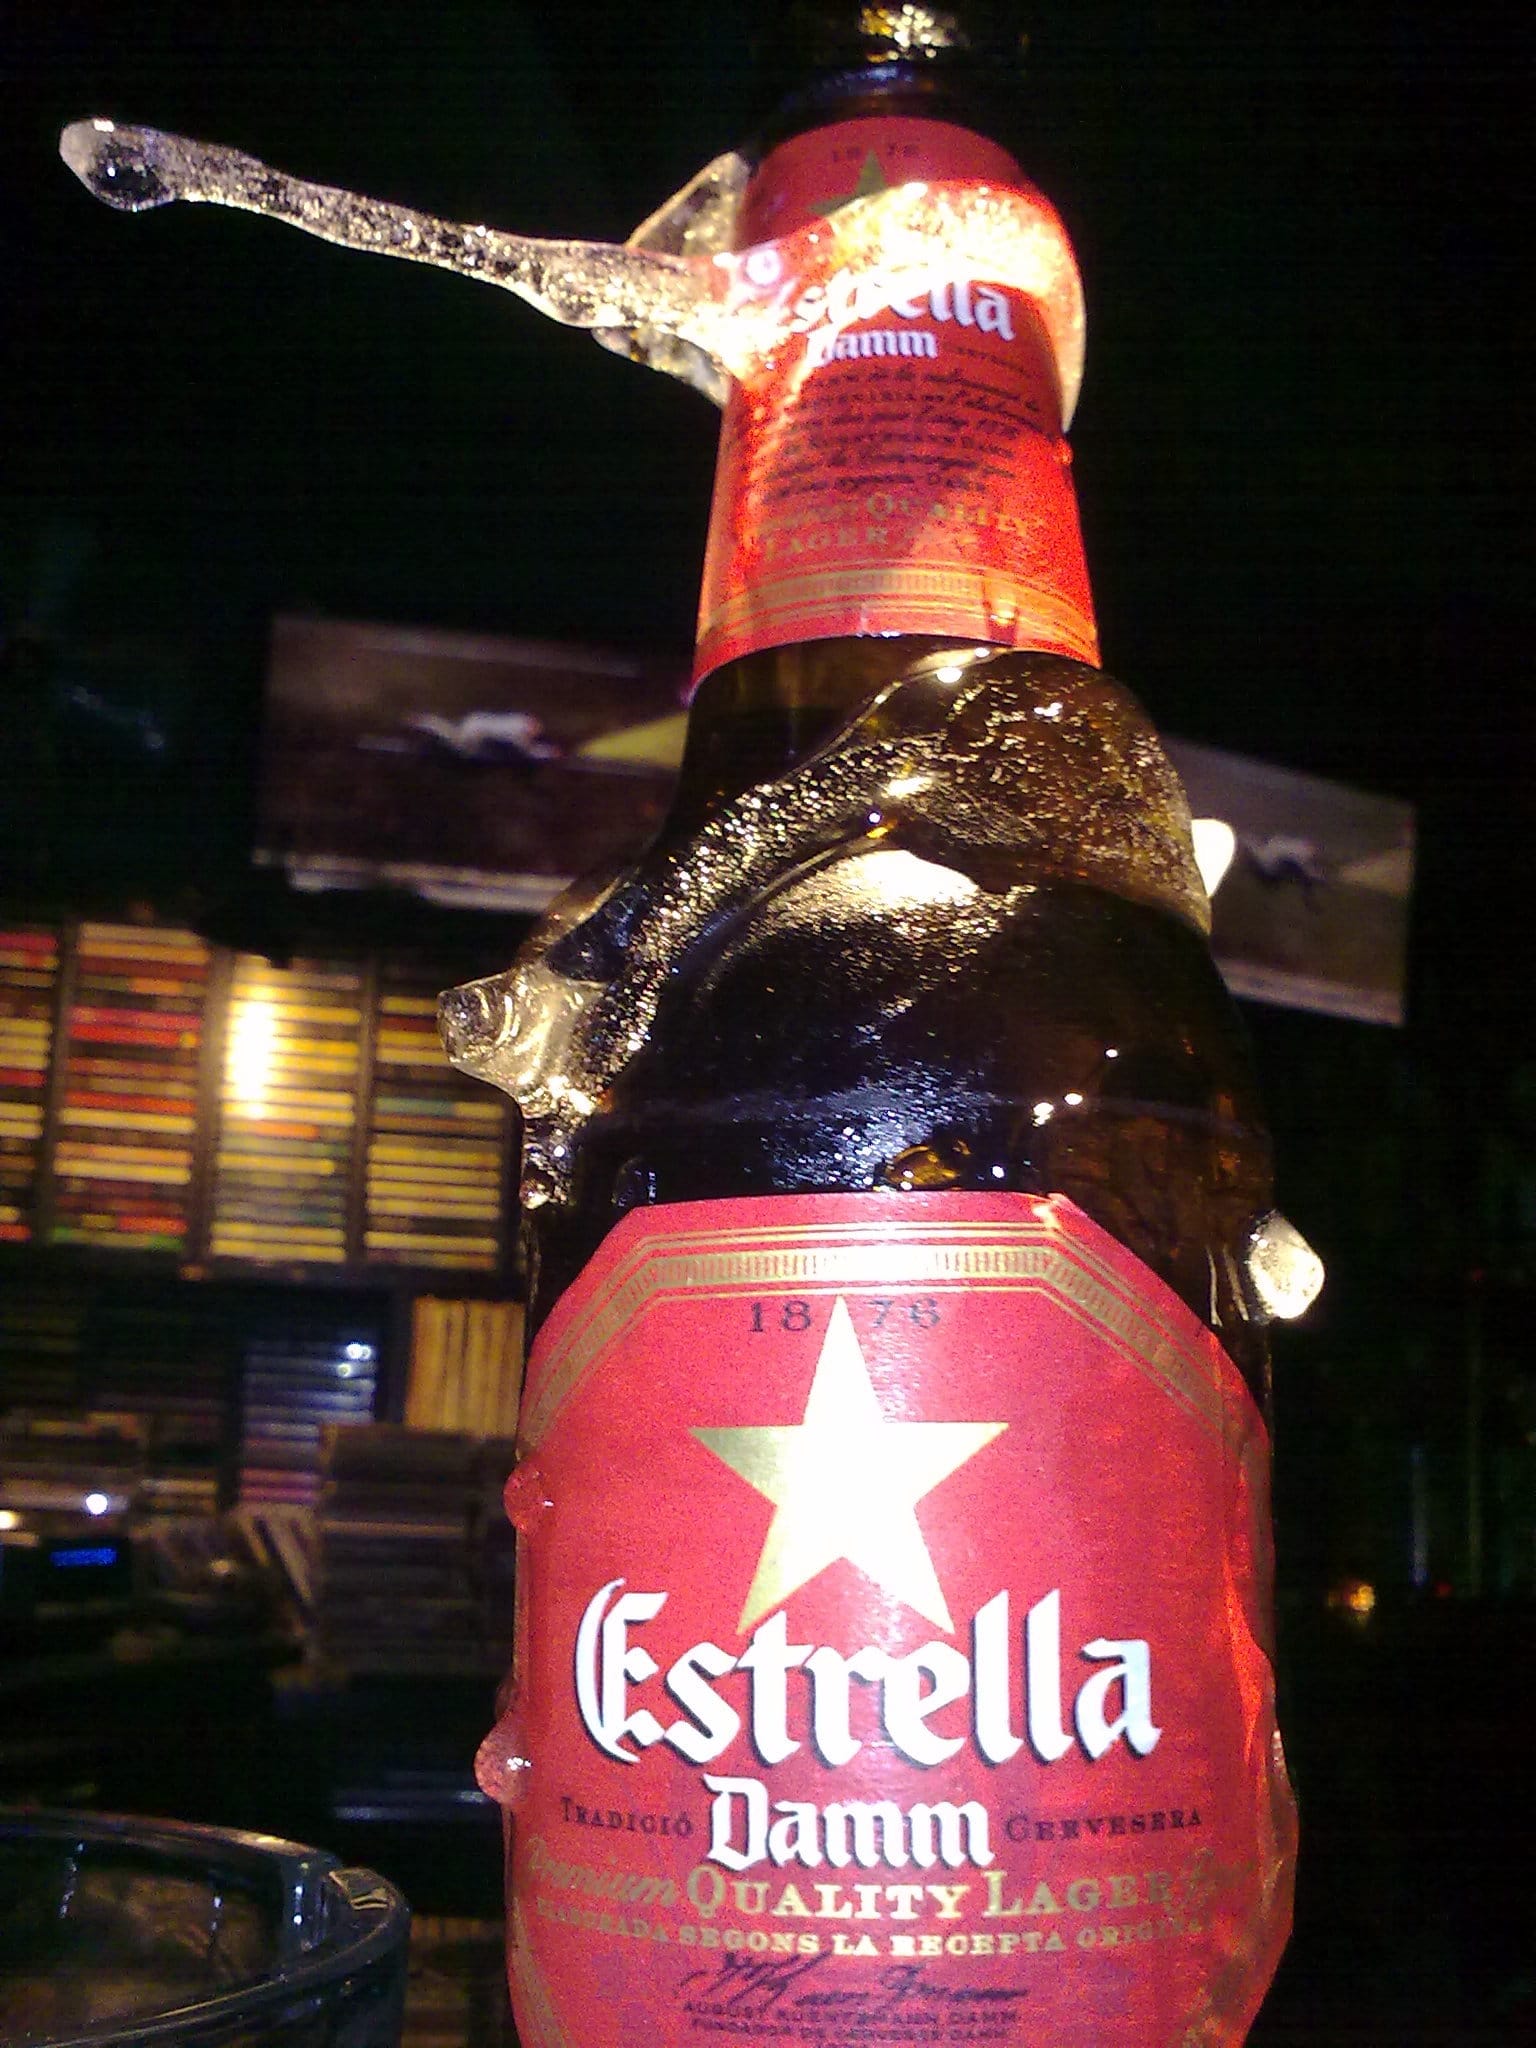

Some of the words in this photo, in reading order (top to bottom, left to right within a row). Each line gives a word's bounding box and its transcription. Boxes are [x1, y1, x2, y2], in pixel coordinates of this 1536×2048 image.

[574, 1577, 1162, 1768] Estrella
[701, 1773, 996, 1872] Damm
[686, 1864, 972, 1920] QUALITY
[981, 1869, 1173, 1919] LAGER
[678, 1925, 821, 1955] SEGONS
[830, 1933, 880, 1957] LA
[889, 1931, 1067, 1957] RECEPTA
